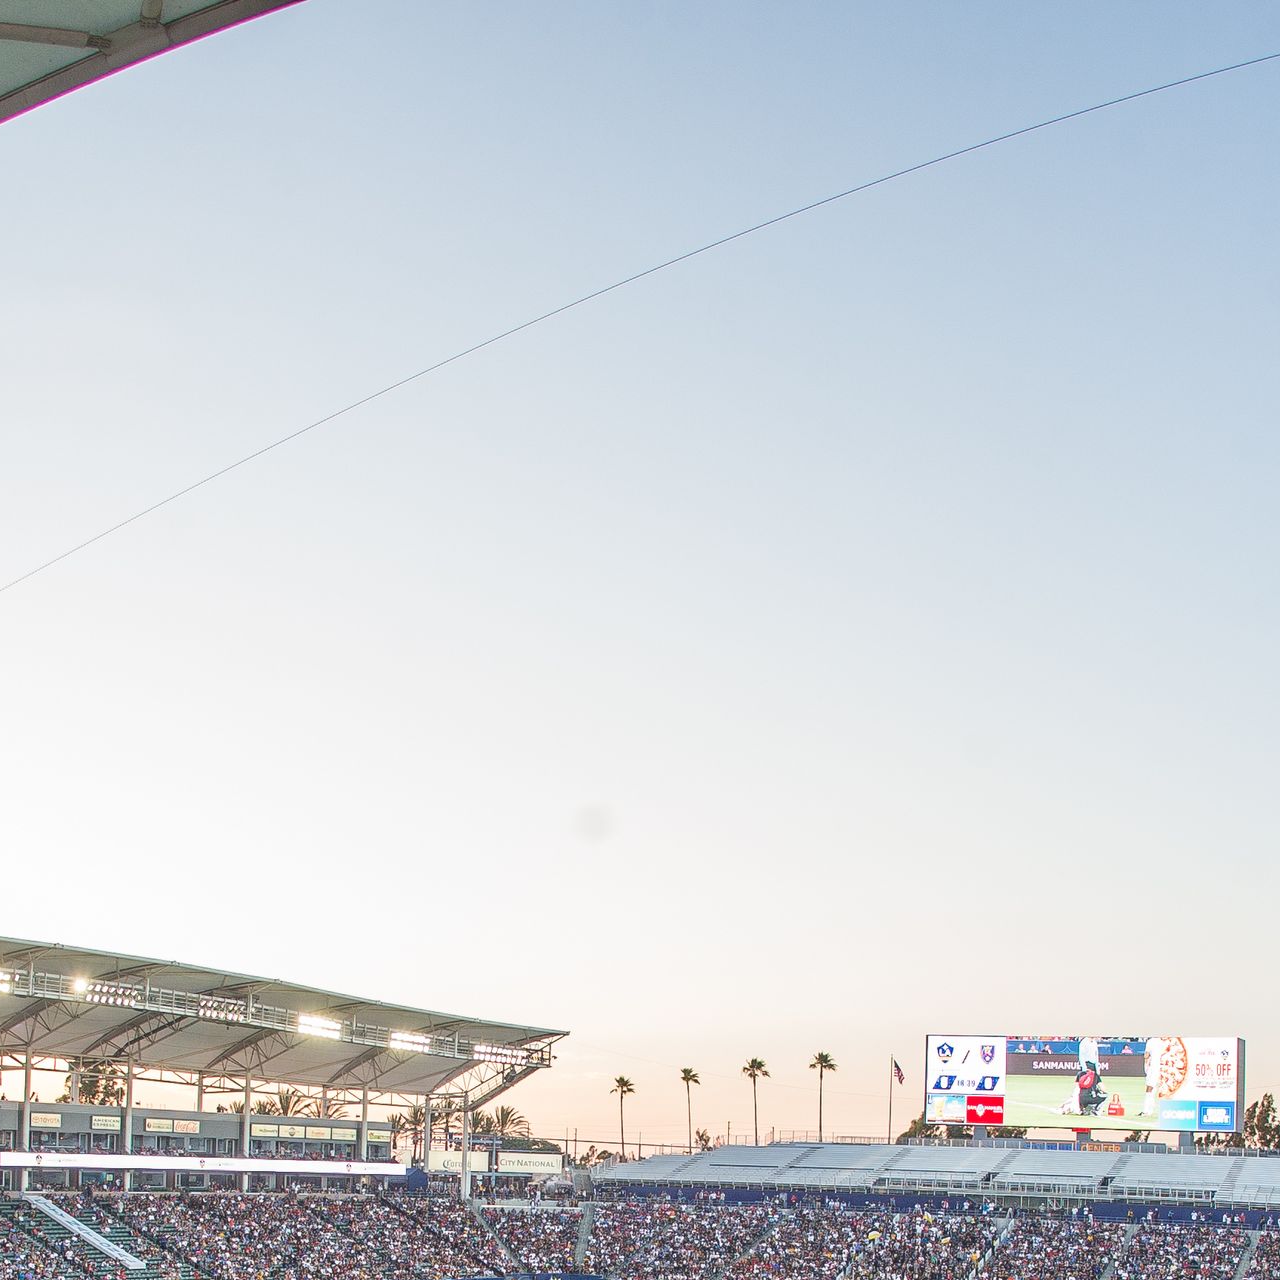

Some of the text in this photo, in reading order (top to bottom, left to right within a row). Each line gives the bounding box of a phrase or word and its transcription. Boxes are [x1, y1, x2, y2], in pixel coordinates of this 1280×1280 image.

[1216, 1064, 1232, 1077] OFF
[499, 1158, 555, 1169] CITY NATIONAL
